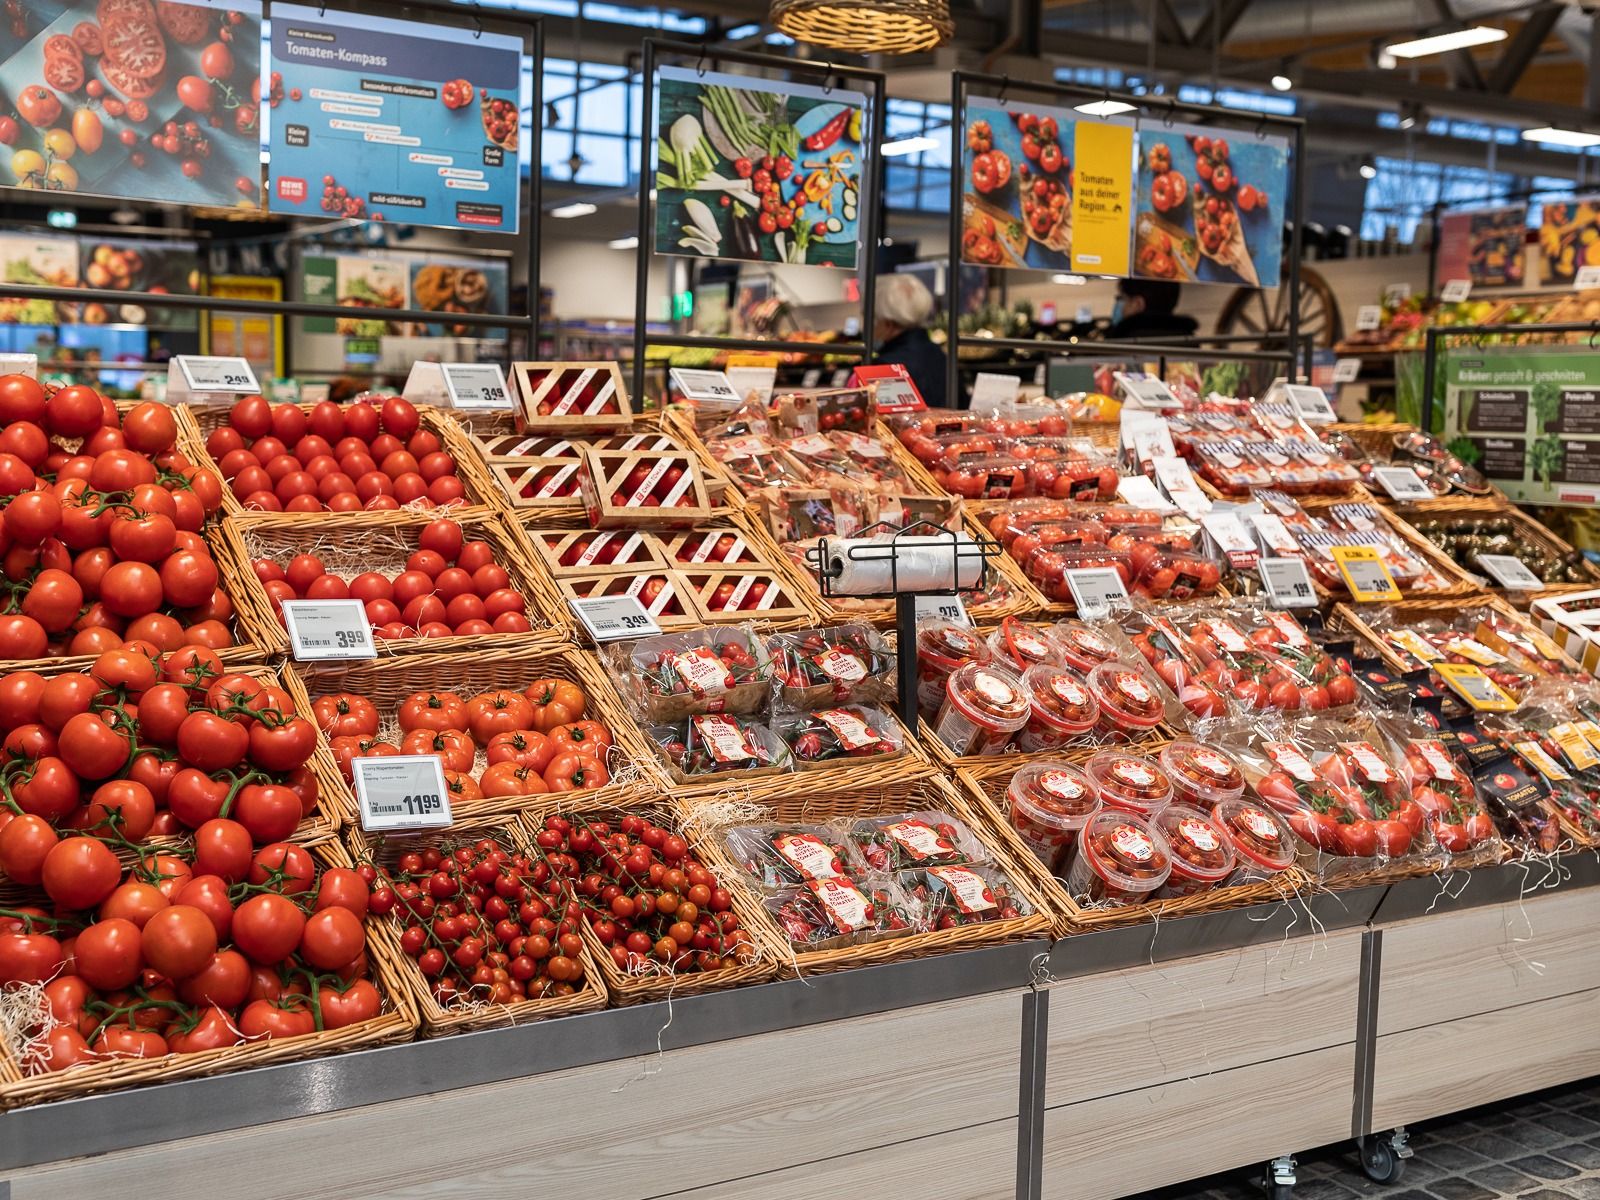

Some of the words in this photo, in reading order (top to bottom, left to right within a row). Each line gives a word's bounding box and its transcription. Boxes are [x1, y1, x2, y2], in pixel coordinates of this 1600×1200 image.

[286, 41, 388, 66] Tomaten-Kompass
[363, 81, 391, 94] besonders
[288, 127, 307, 136] Kleine
[288, 135, 304, 144] Form
[1080, 171, 1114, 186] Tomaten
[1080, 188, 1094, 198] aus
[1096, 189, 1120, 200] deiner
[621, 615, 649, 629] 3.49
[335, 630, 365, 648] 3.99
[1506, 785, 1539, 802] TOMATEN
[402, 794, 441, 815] 11.99
